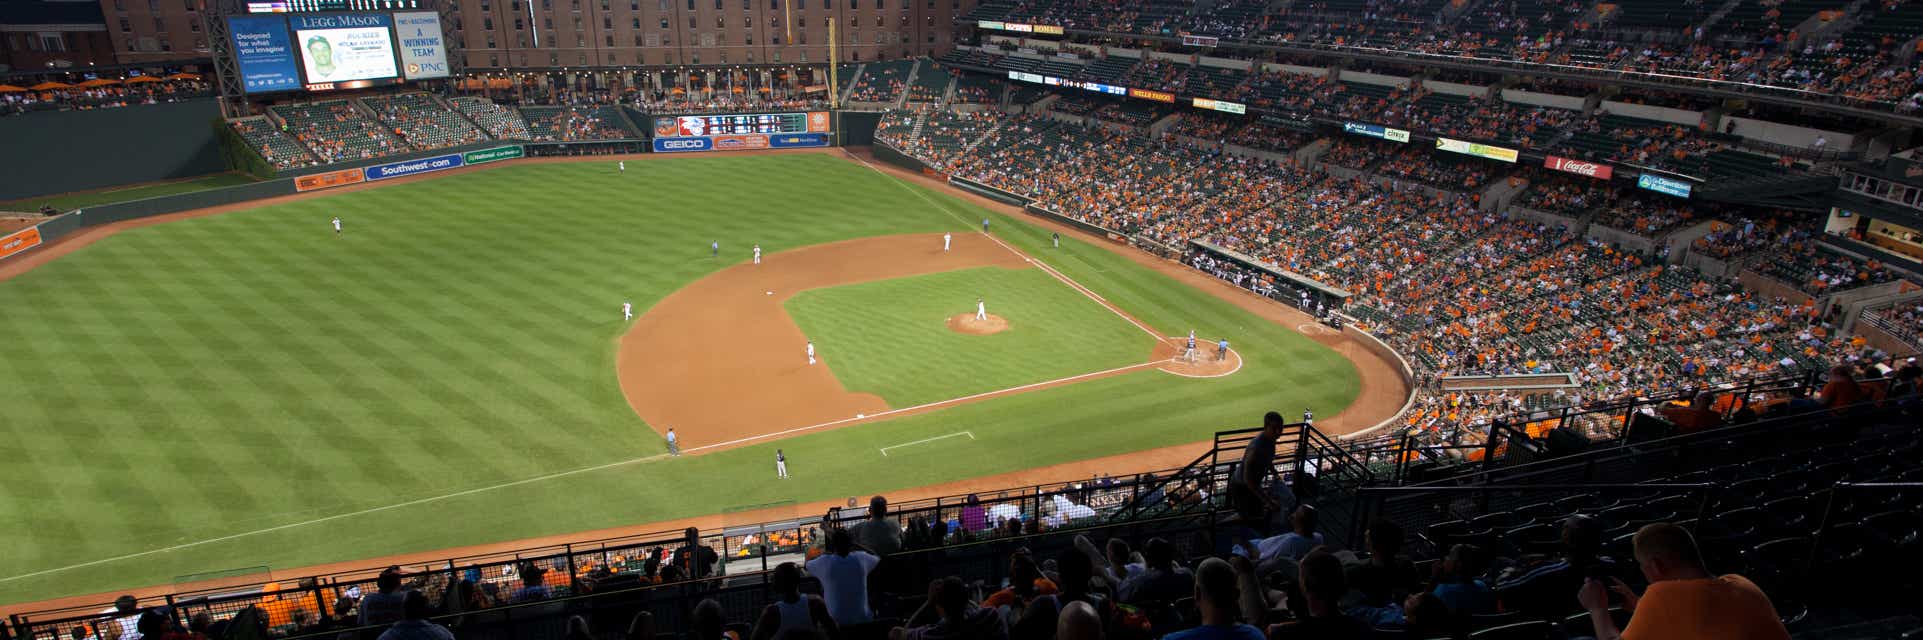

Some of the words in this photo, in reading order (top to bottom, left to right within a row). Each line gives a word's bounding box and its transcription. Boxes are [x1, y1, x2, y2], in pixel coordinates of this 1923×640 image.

[302, 17, 336, 28] LEGG
[337, 15, 380, 27] MASON
[236, 33, 271, 41] Designed
[417, 28, 423, 37] A
[403, 37, 439, 48] WINNING
[255, 46, 284, 54] imagine
[412, 48, 435, 57] TEAM
[421, 63, 445, 72] PNC
[664, 139, 704, 149] GEICO
